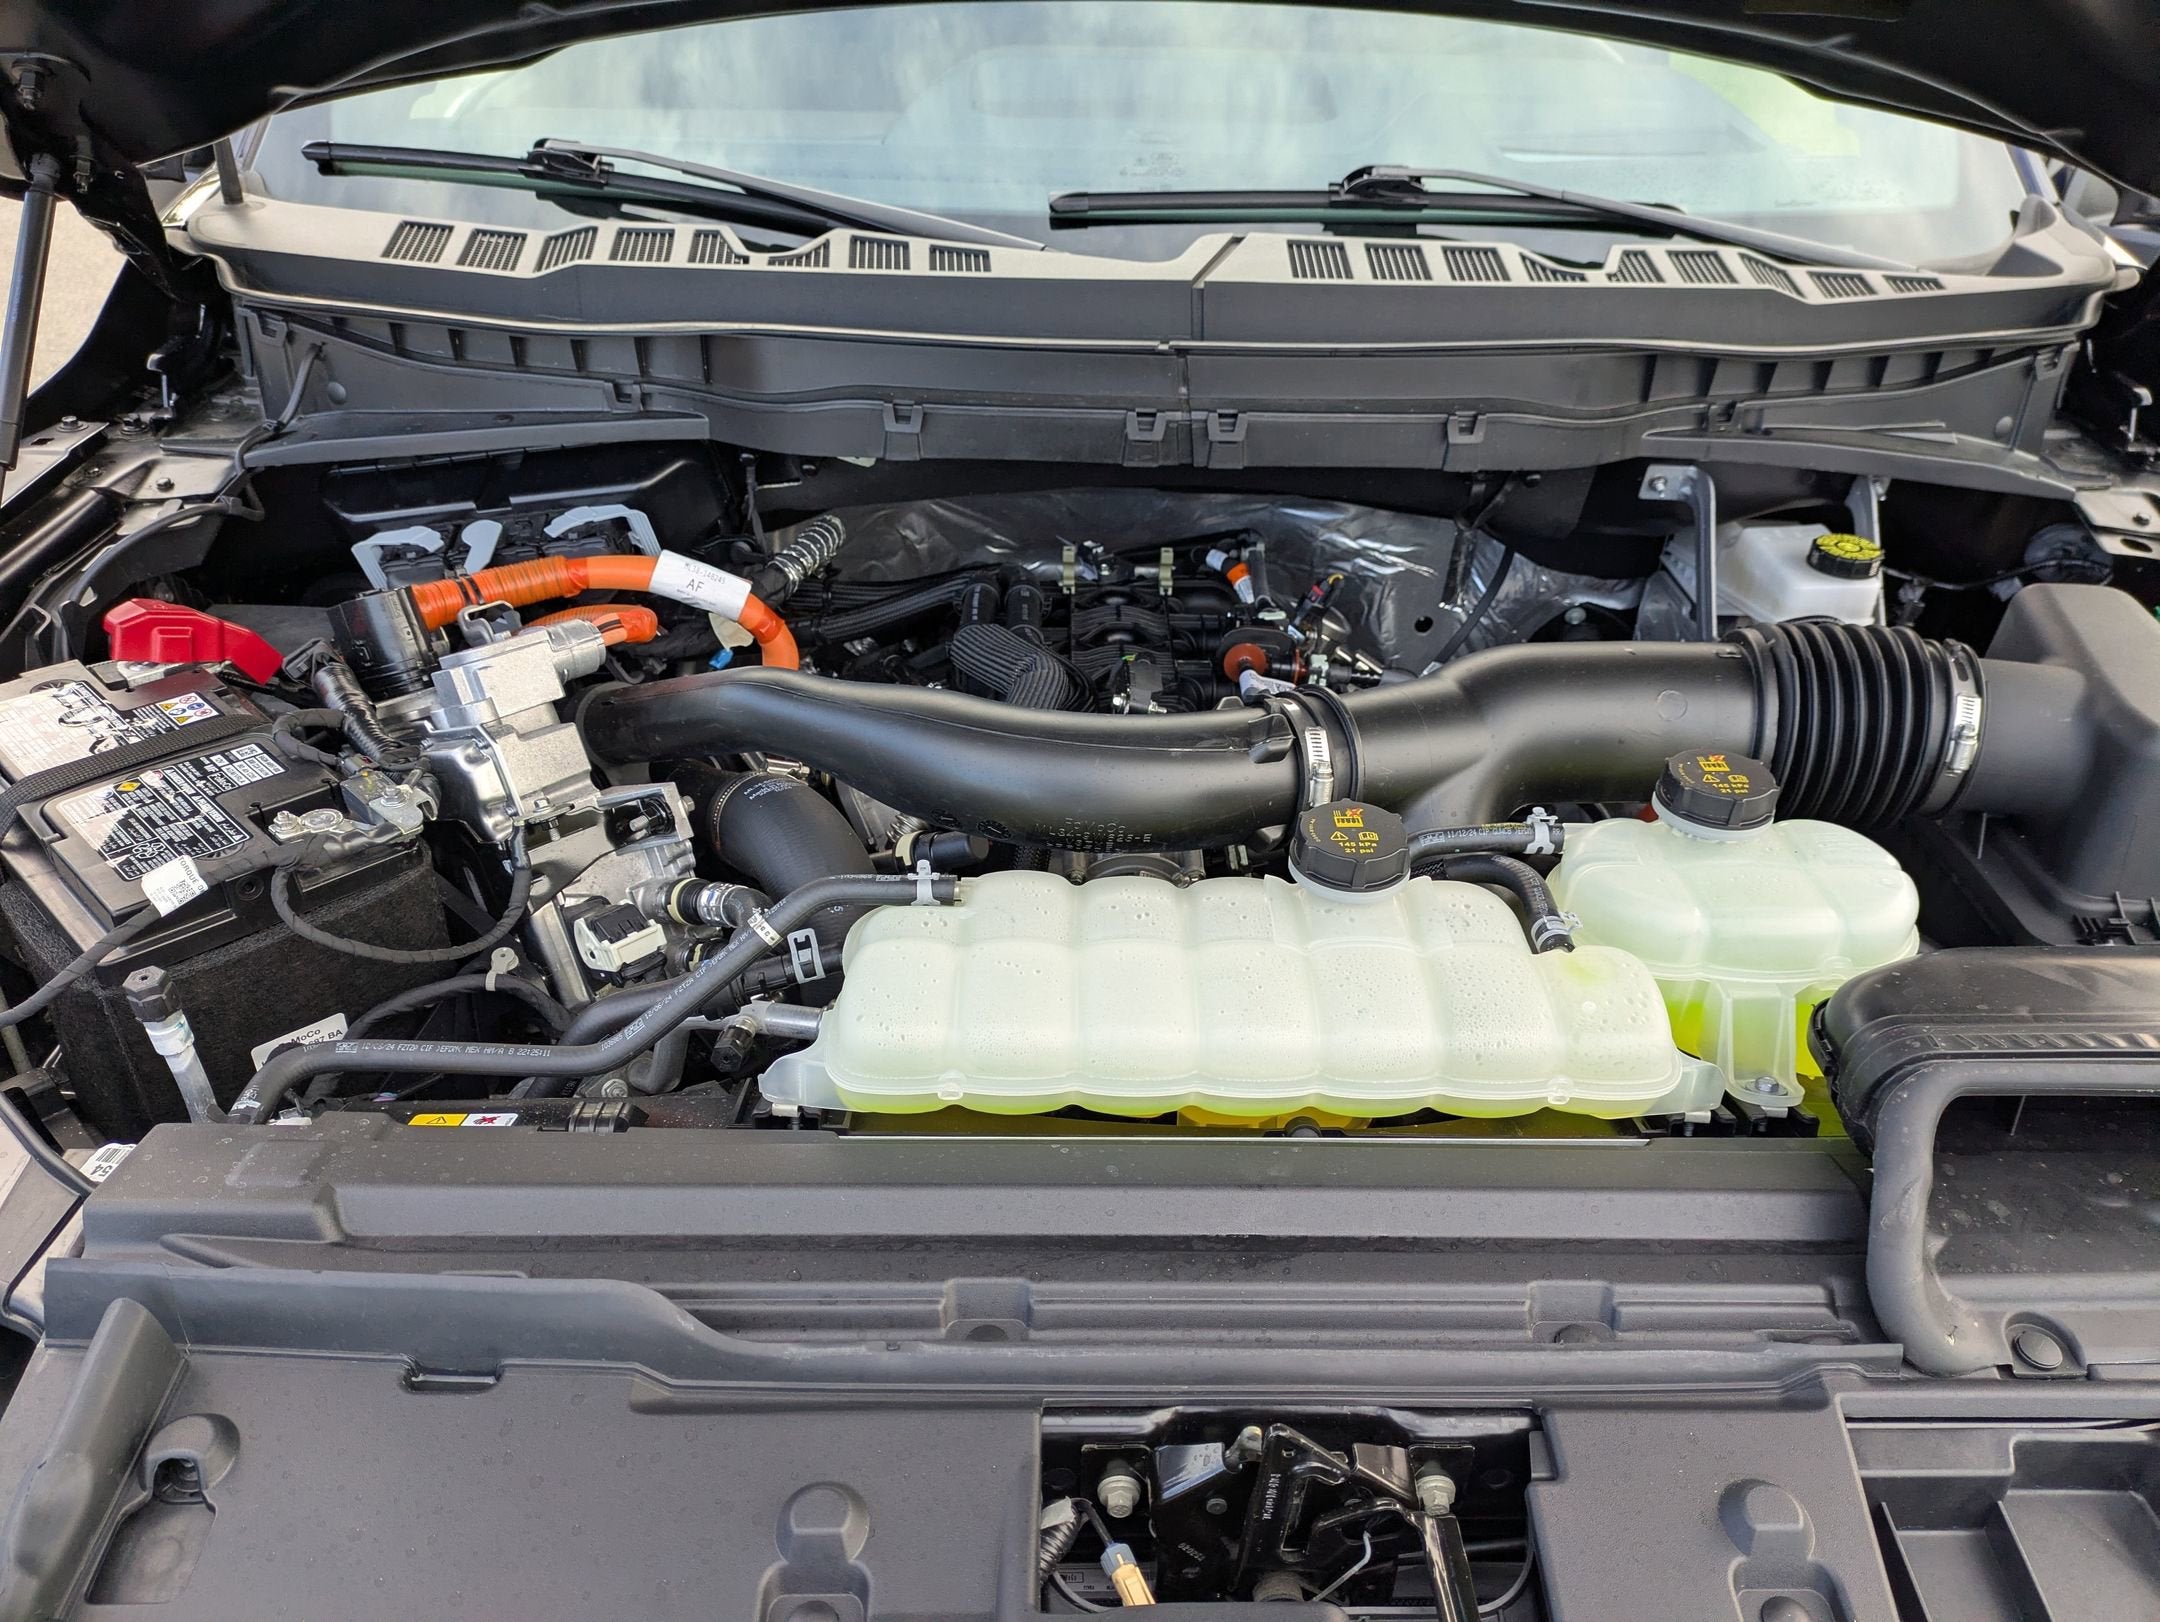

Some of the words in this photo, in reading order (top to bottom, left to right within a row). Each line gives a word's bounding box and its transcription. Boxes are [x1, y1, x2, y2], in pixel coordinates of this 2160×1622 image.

[686, 578, 705, 592] AF
[179, 857, 199, 884] TORQUE
[290, 1027, 321, 1045] MoCo
[327, 1028, 343, 1040] BA
[90, 1164, 112, 1177] 54
